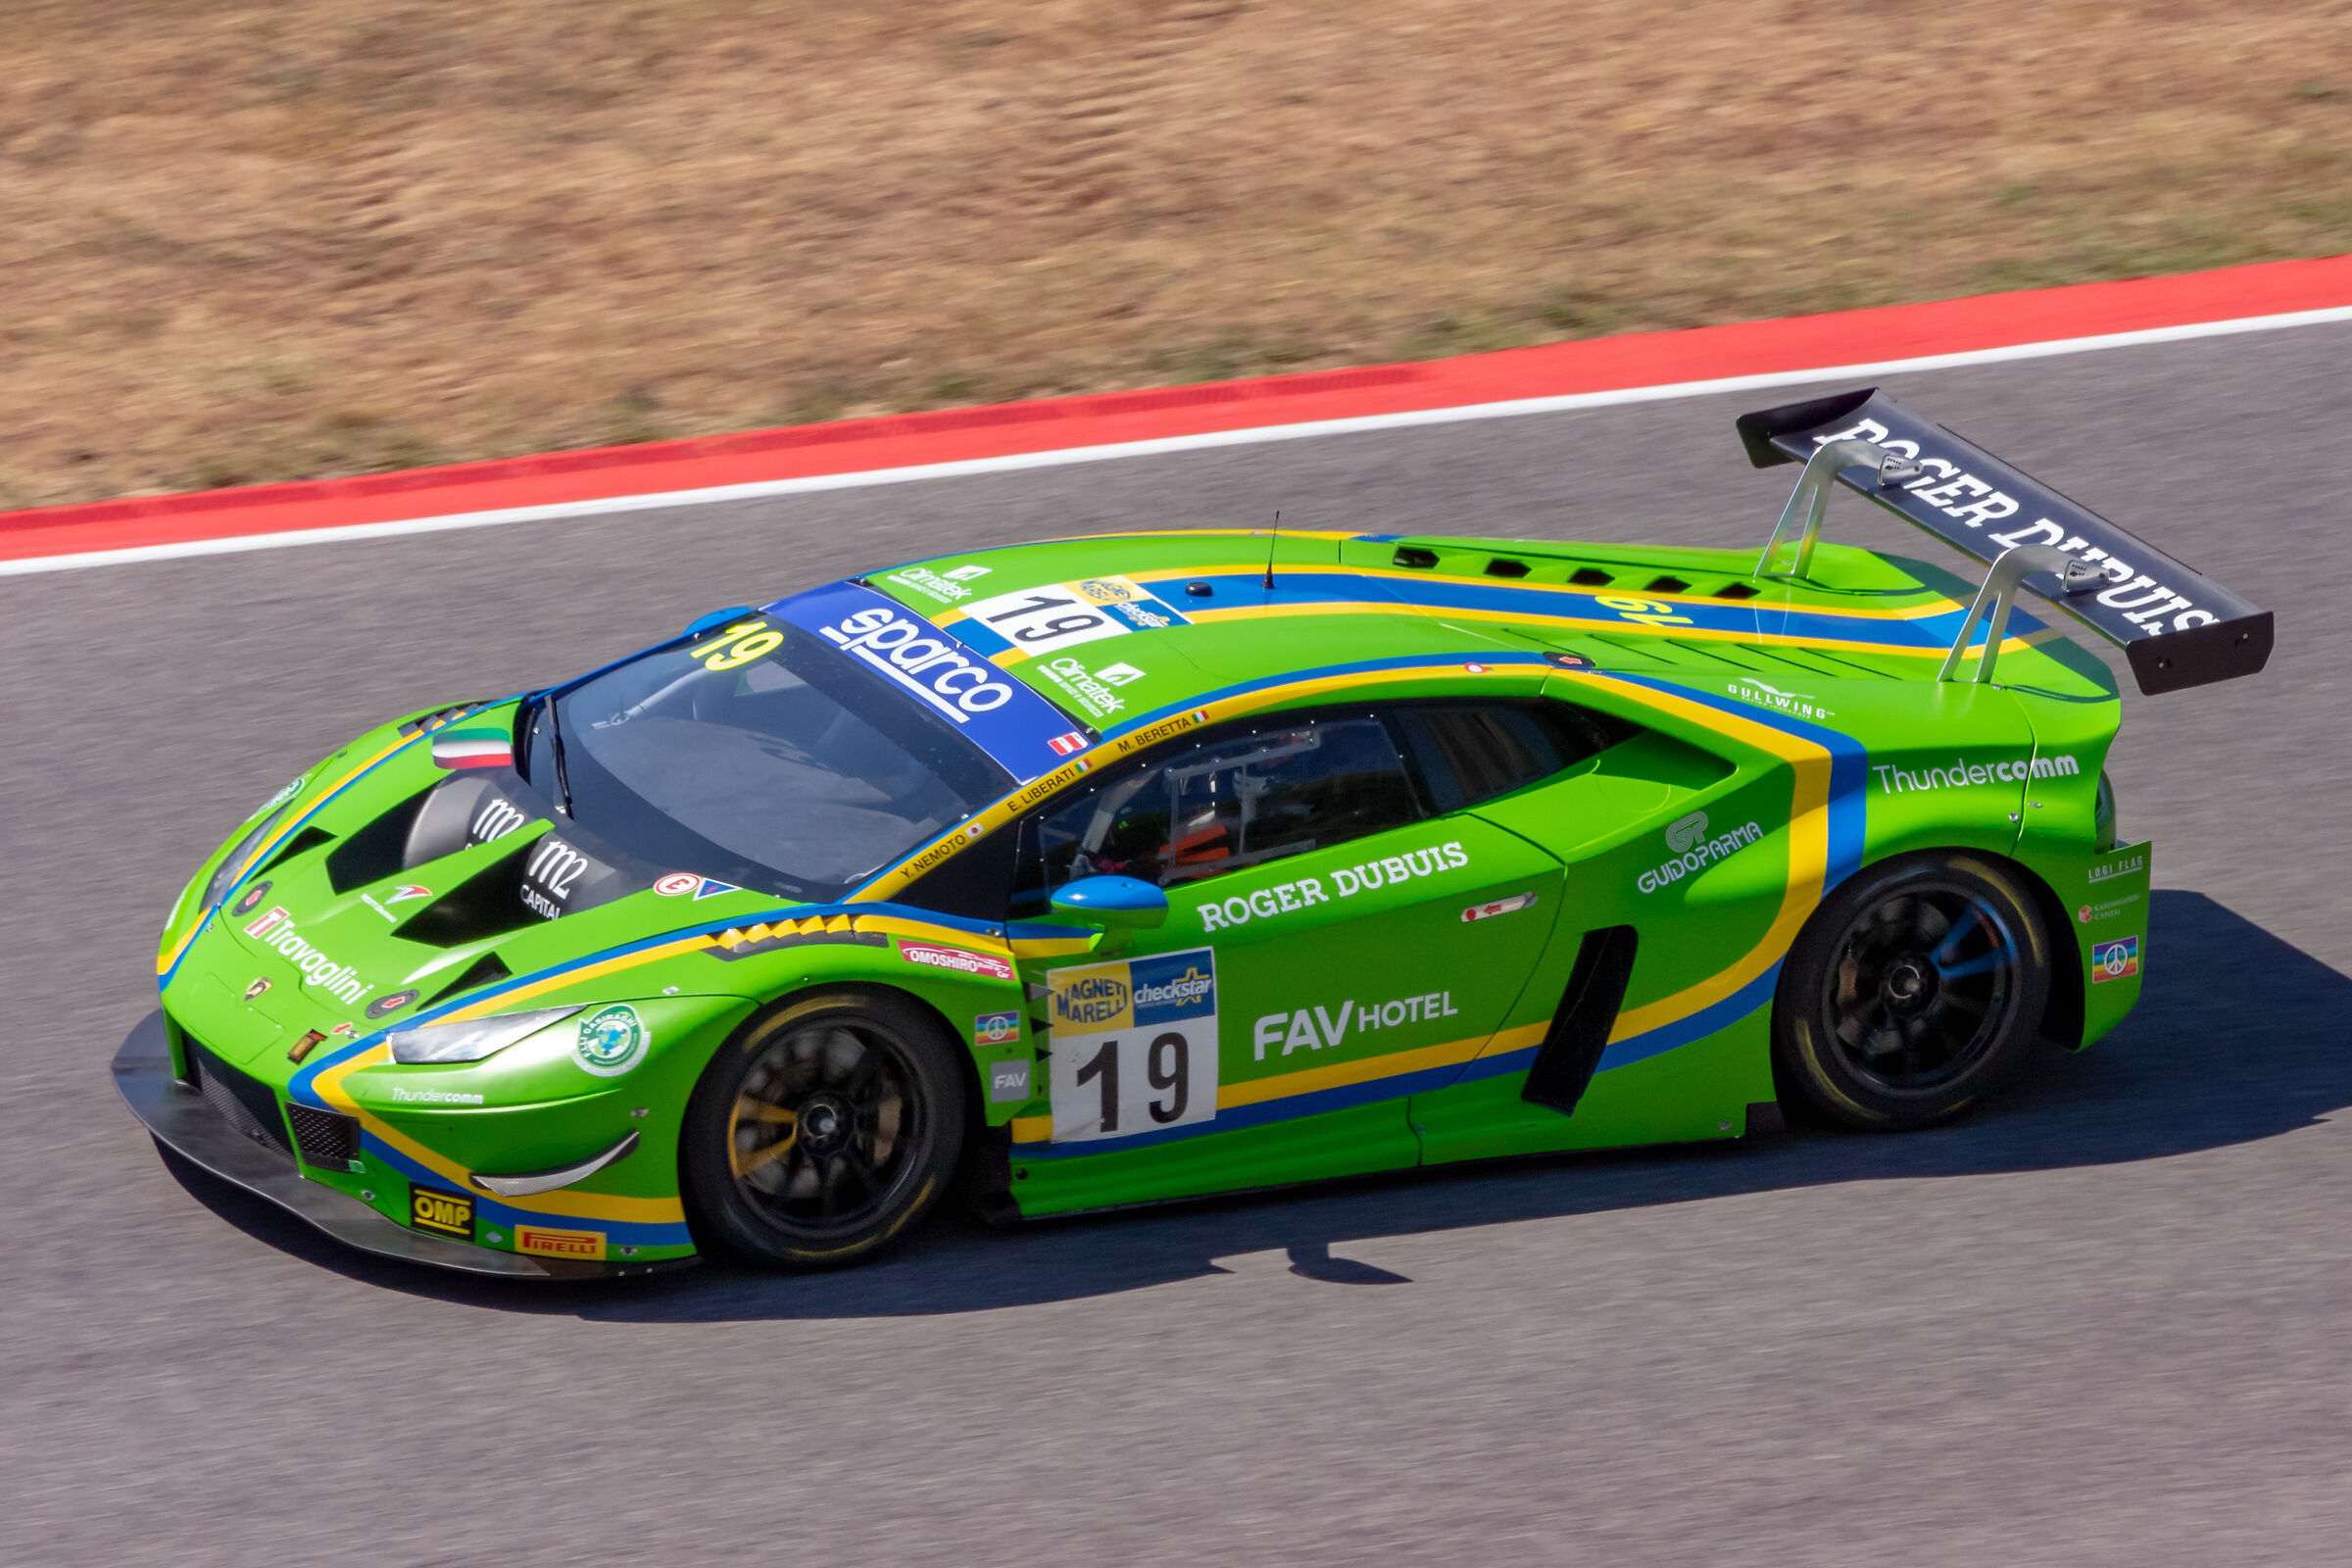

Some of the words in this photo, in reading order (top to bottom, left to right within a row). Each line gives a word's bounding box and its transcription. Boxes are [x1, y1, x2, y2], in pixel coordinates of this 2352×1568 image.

[1988, 517, 2220, 635] DUIS
[985, 596, 1104, 642] 19
[691, 620, 784, 671] 19
[840, 608, 1013, 712] sparco
[1051, 658, 1125, 714] Climatek
[1728, 684, 1826, 719] GULLWING
[1117, 741, 1135, 754] M.
[1135, 717, 1192, 747] BERETTA
[1007, 800, 1022, 812] E.
[1023, 768, 1076, 806] LIBERATI
[1872, 755, 2080, 795] Thundercomm
[900, 866, 913, 879] Y.
[913, 834, 966, 872] NEMOTO
[1638, 821, 1764, 894] GUIDOPARMA
[2088, 864, 2113, 879] LOGI
[2119, 856, 2143, 871] FLAG
[666, 878, 691, 891] E
[1197, 878, 1329, 932] ROGER
[1336, 842, 1469, 899] DUBUIS
[265, 919, 374, 1005] Travaglini
[909, 950, 979, 973] OMOSHIRO
[1133, 979, 1212, 1004] checkstar
[1252, 1000, 1355, 1060] FAV
[1357, 991, 1458, 1033] HOTEL
[393, 1087, 484, 1105] Thundercomm
[994, 1072, 1028, 1090] FAV
[1076, 1030, 1191, 1134] 19
[415, 1200, 471, 1228] OMP
[522, 1231, 597, 1254] PIRELLI
